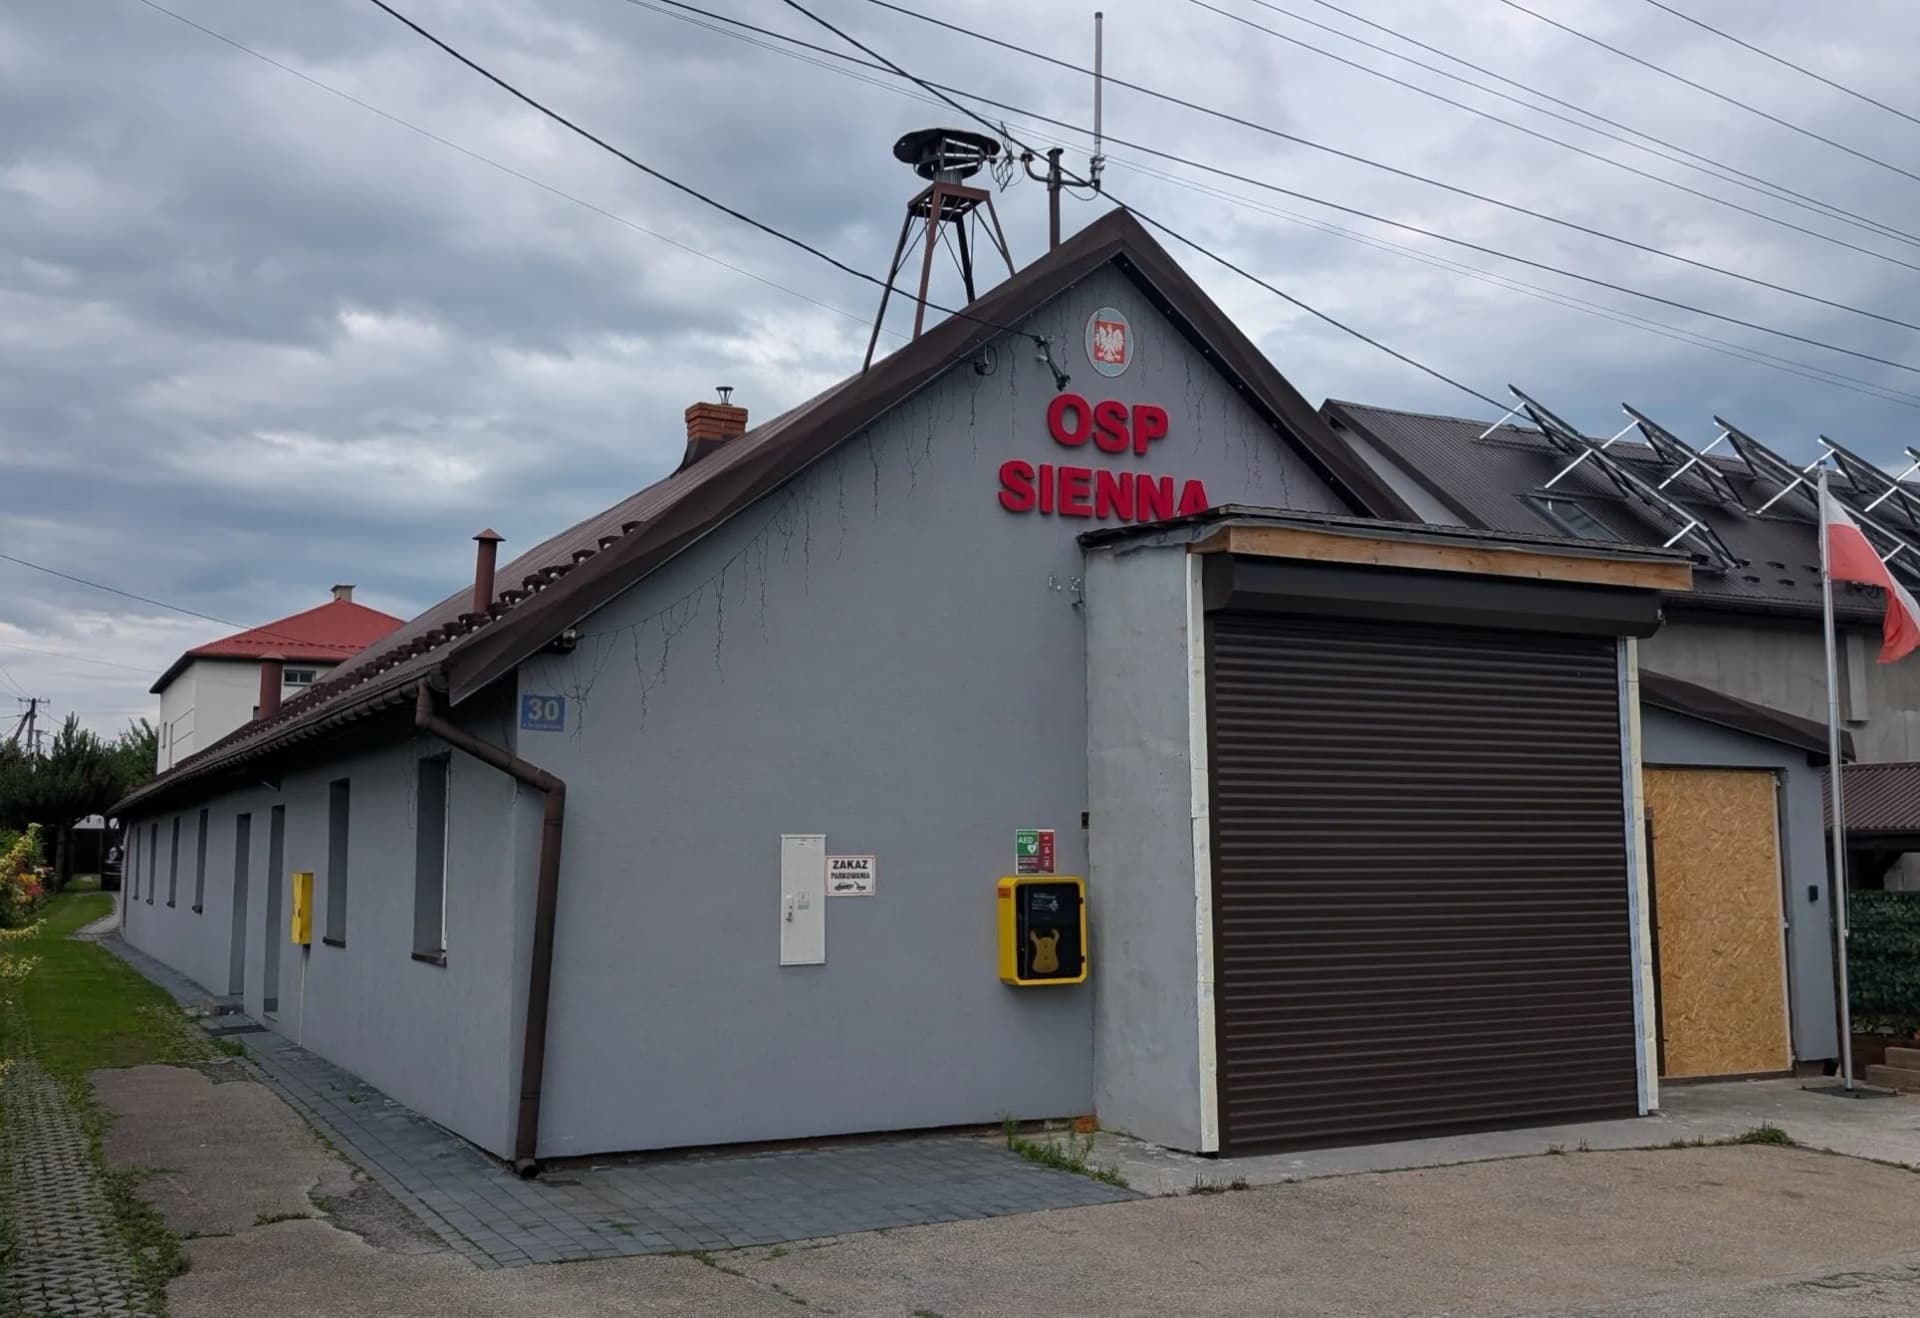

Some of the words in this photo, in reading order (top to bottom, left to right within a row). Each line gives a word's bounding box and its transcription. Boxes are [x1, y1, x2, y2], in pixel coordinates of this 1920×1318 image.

[1047, 392, 1169, 455] OSP
[998, 460, 1209, 522] SIENNA
[528, 699, 559, 720] 30
[1018, 836, 1034, 844] AED
[833, 860, 868, 869] ZAKAZ
